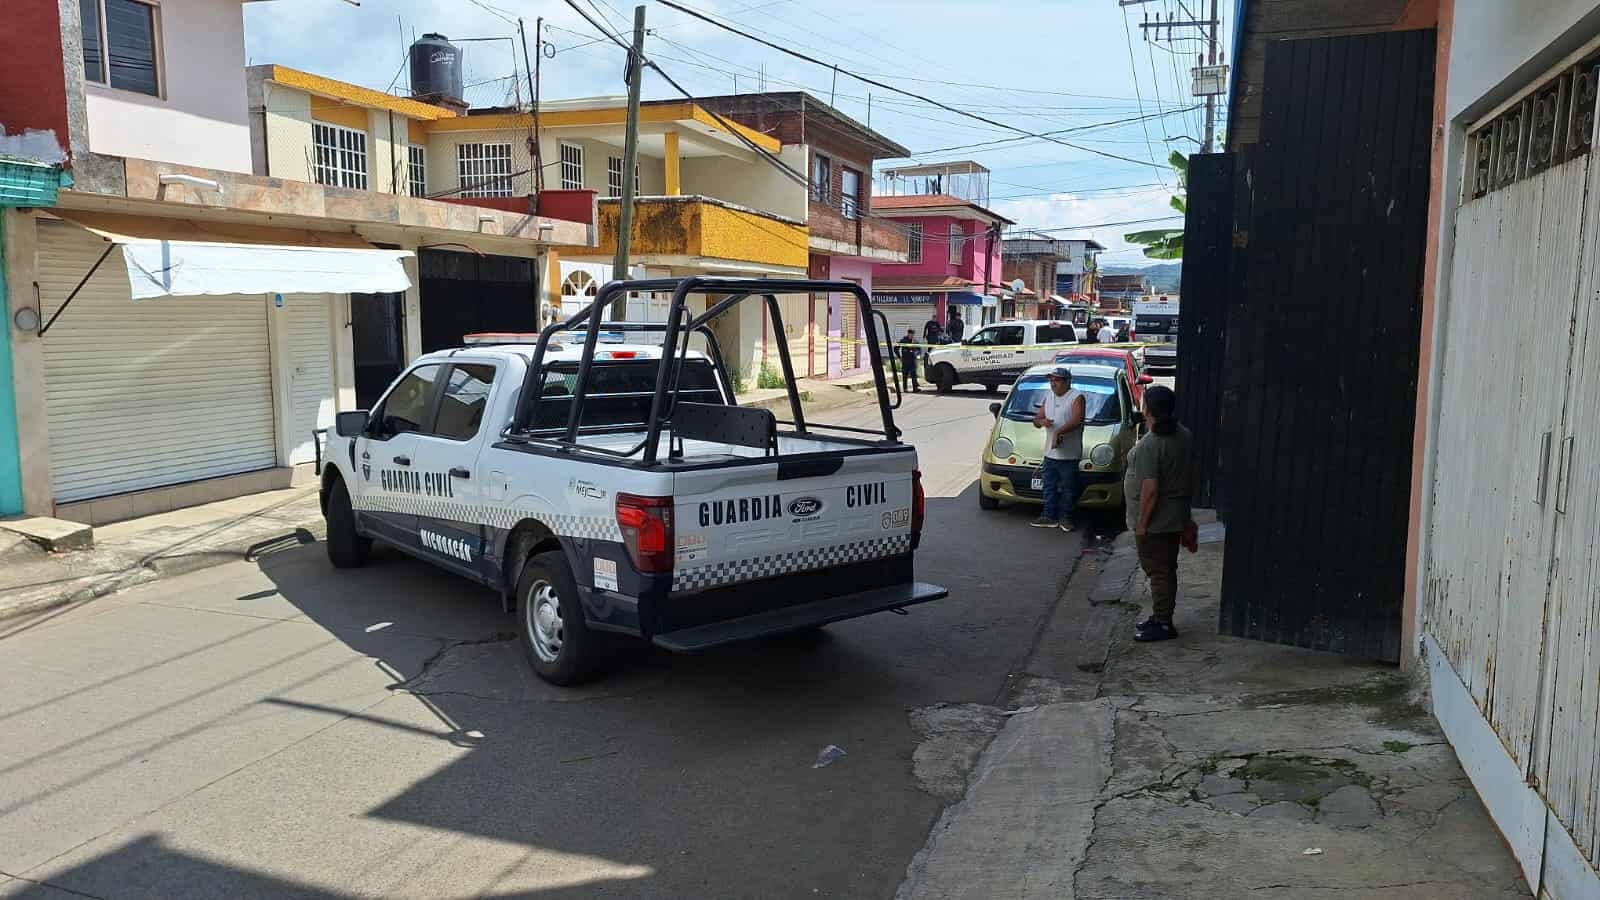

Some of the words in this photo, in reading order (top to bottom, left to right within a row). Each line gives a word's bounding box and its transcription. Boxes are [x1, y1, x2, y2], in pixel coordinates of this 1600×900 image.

[381, 469, 421, 495] GUARDIA
[424, 471, 454, 498] CIVIL
[699, 494, 783, 528] GUARDIA
[846, 481, 887, 508] CIVIL
[420, 528, 473, 563] MICHOACÁN
